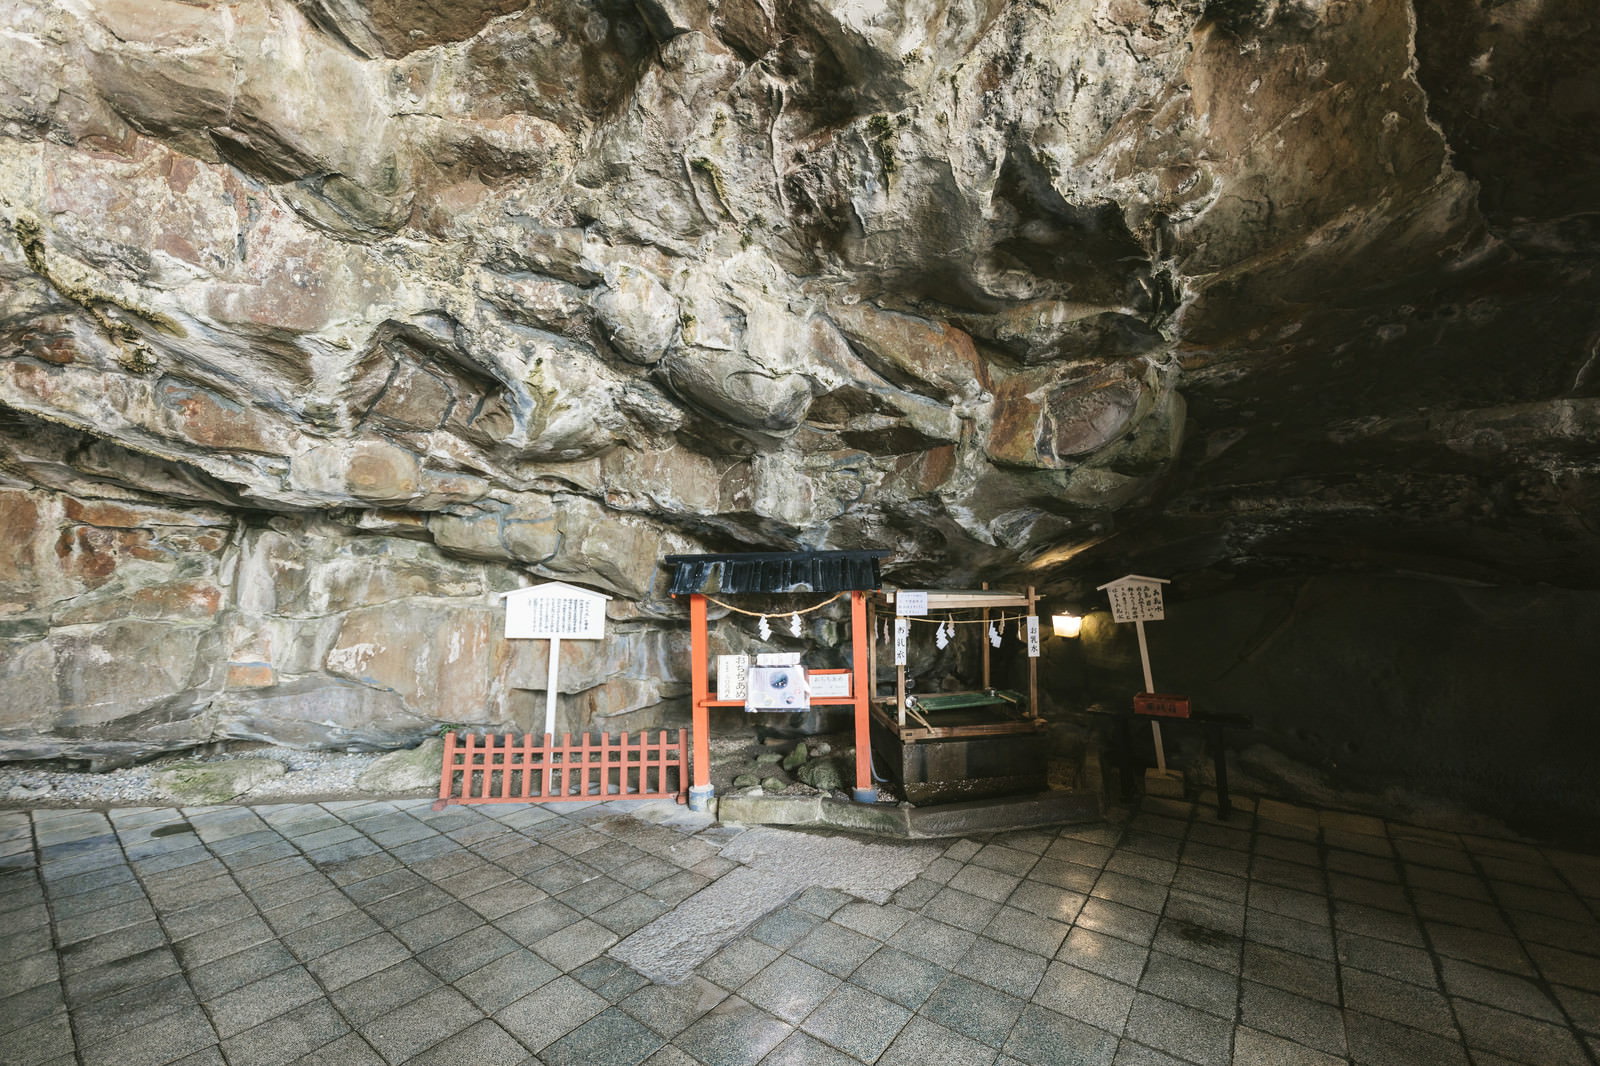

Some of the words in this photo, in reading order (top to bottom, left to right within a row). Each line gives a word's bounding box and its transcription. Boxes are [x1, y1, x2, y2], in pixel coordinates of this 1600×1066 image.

[1030, 627, 1038, 653] お乳水
[735, 655, 746, 698] おちちあめ
